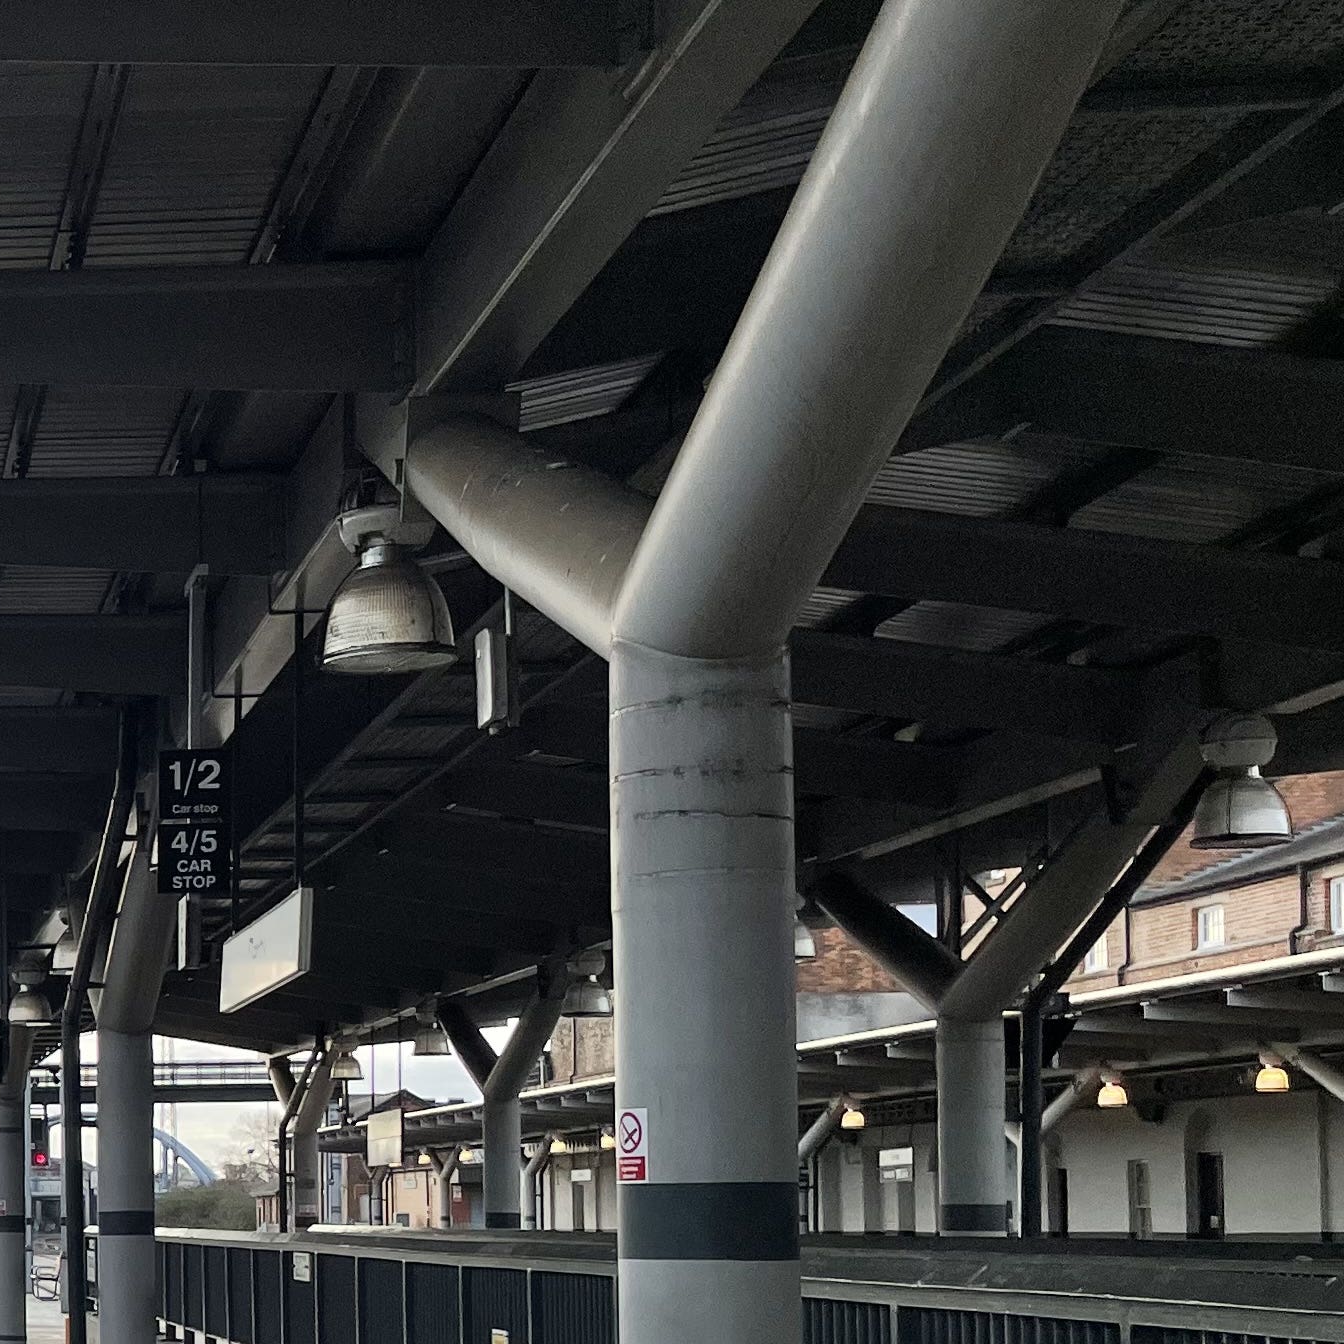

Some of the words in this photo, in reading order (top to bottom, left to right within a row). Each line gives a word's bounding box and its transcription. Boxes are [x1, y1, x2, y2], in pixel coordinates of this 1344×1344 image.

[169, 758, 221, 798] 1/2
[172, 804, 191, 814] Car
[193, 803, 219, 814] stop
[171, 828, 218, 856] 4/5
[176, 859, 212, 873] CAR
[172, 875, 217, 889] STOP
